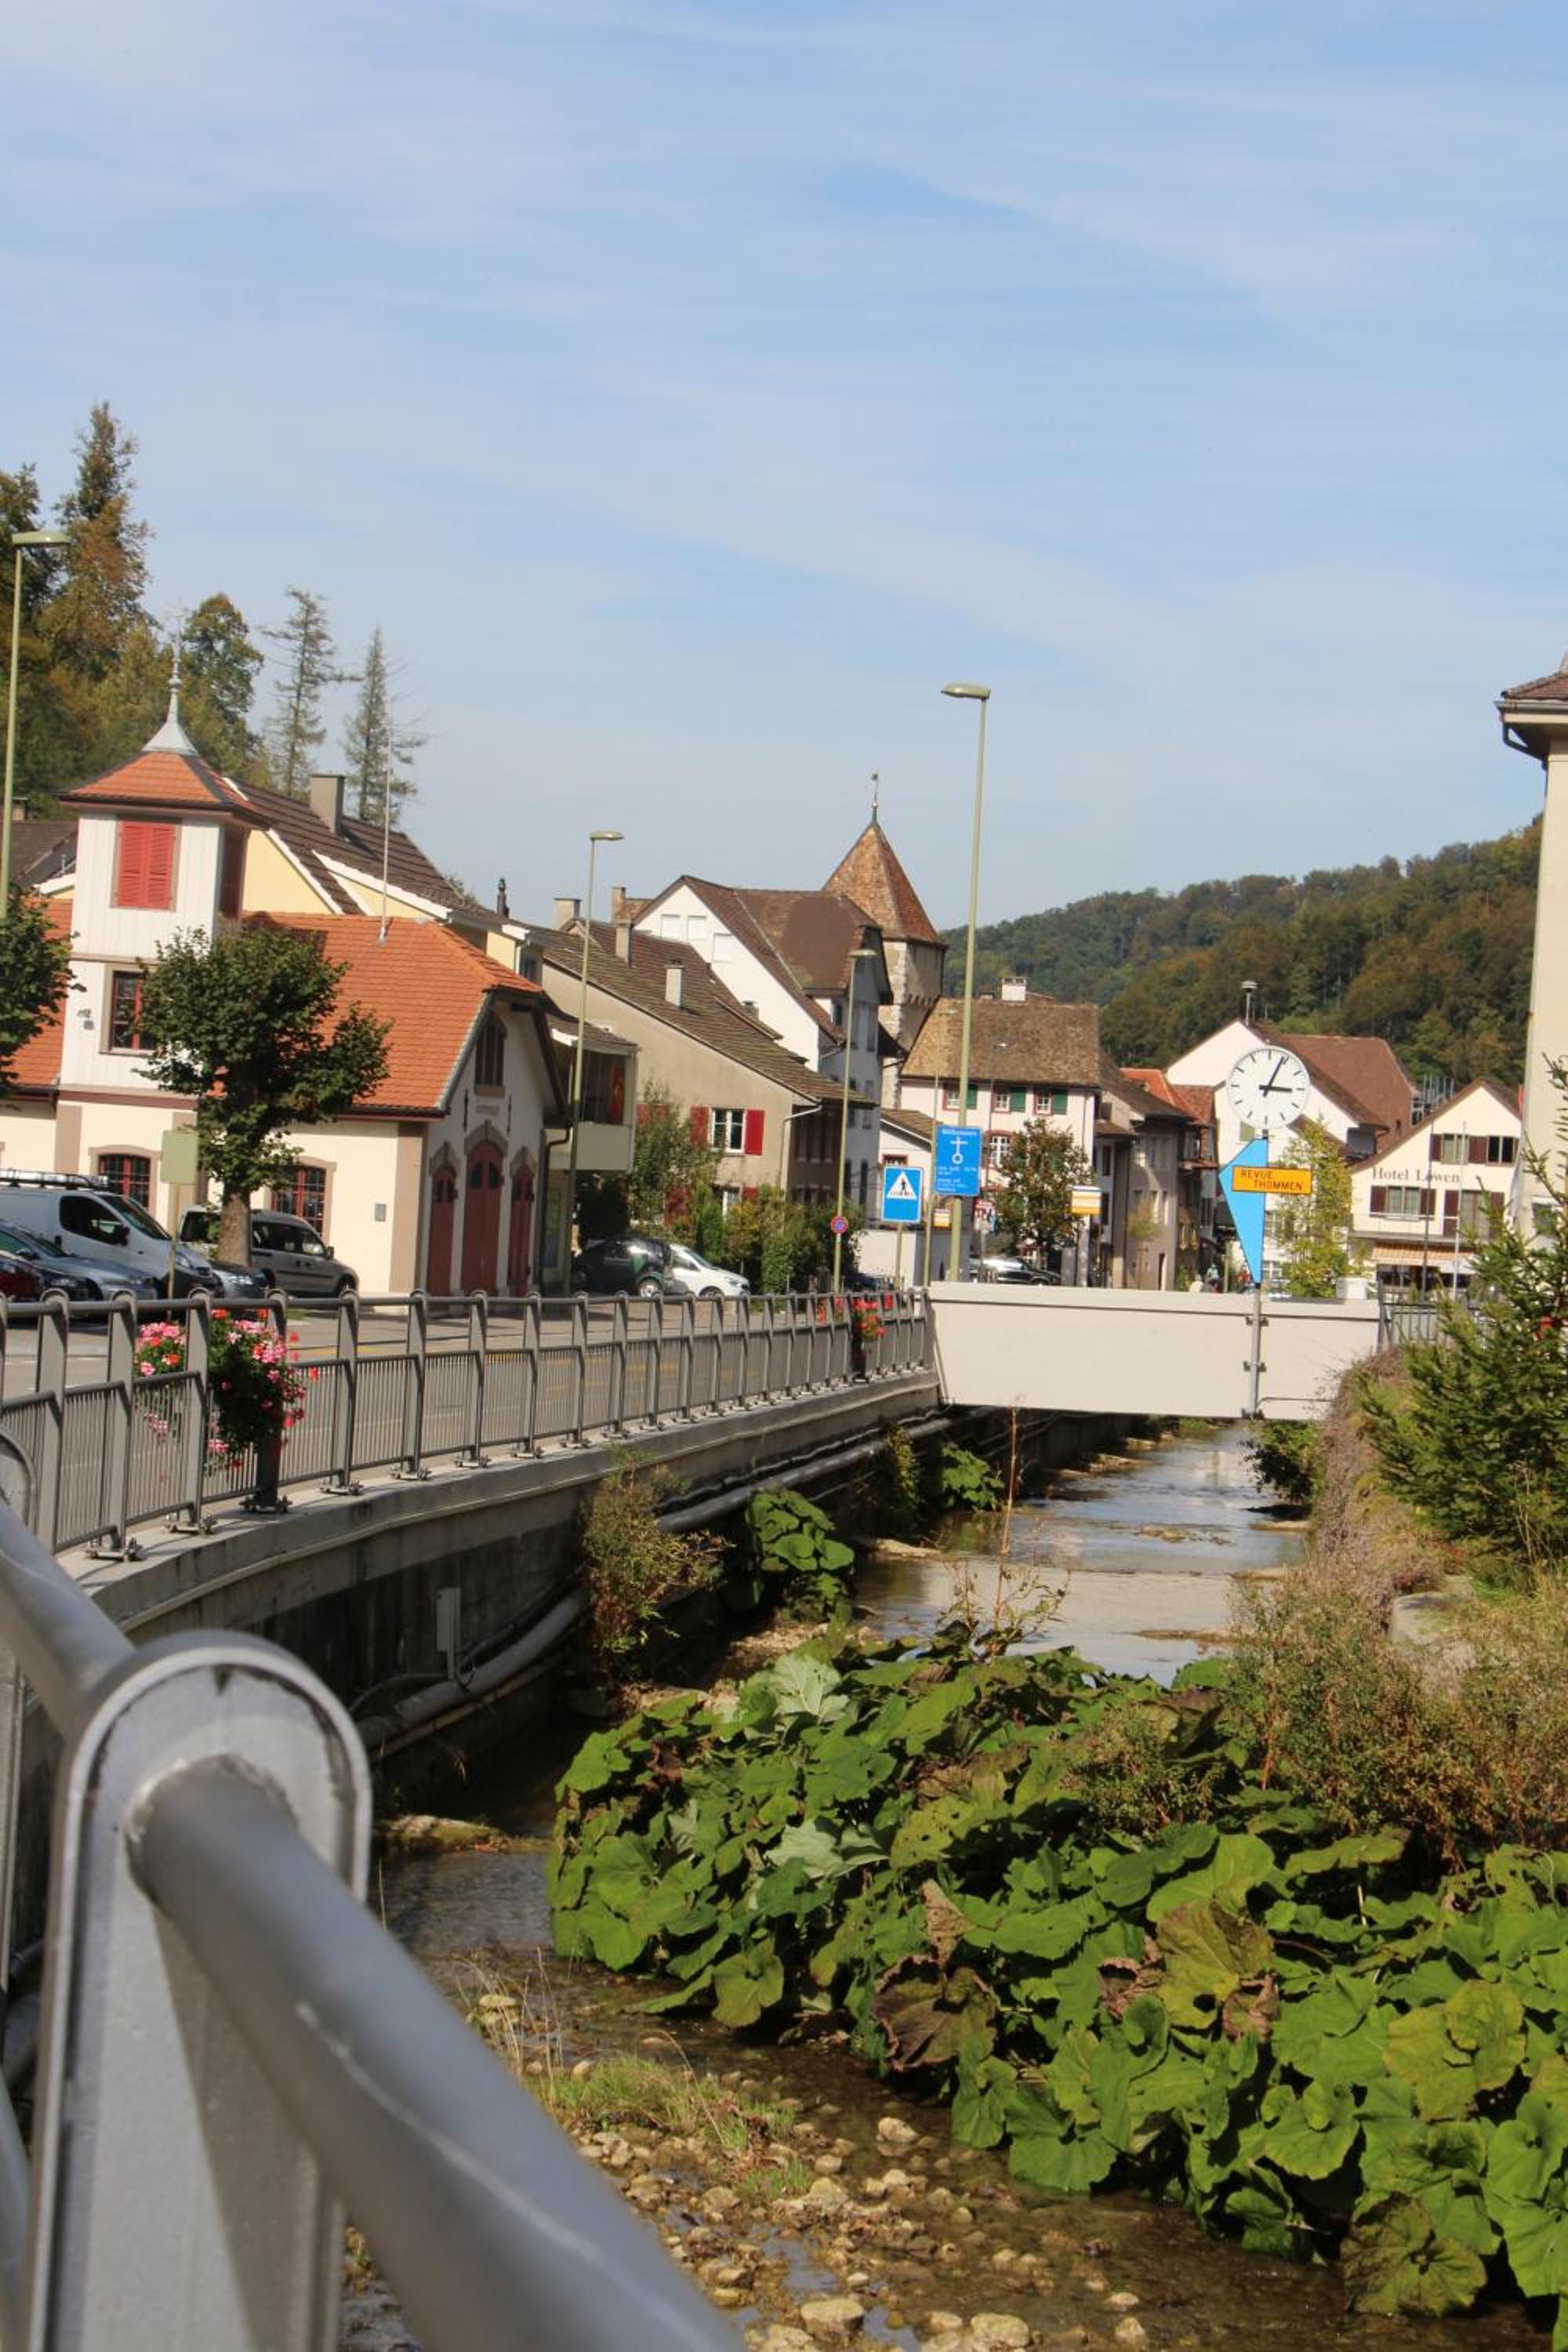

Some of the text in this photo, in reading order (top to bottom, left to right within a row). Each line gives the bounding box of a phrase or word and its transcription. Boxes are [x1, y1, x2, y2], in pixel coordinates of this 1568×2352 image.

[1241, 1169, 1274, 1180] REVUE
[1372, 1167, 1409, 1180] Hotel
[1254, 1179, 1302, 1191] THOMMEN
